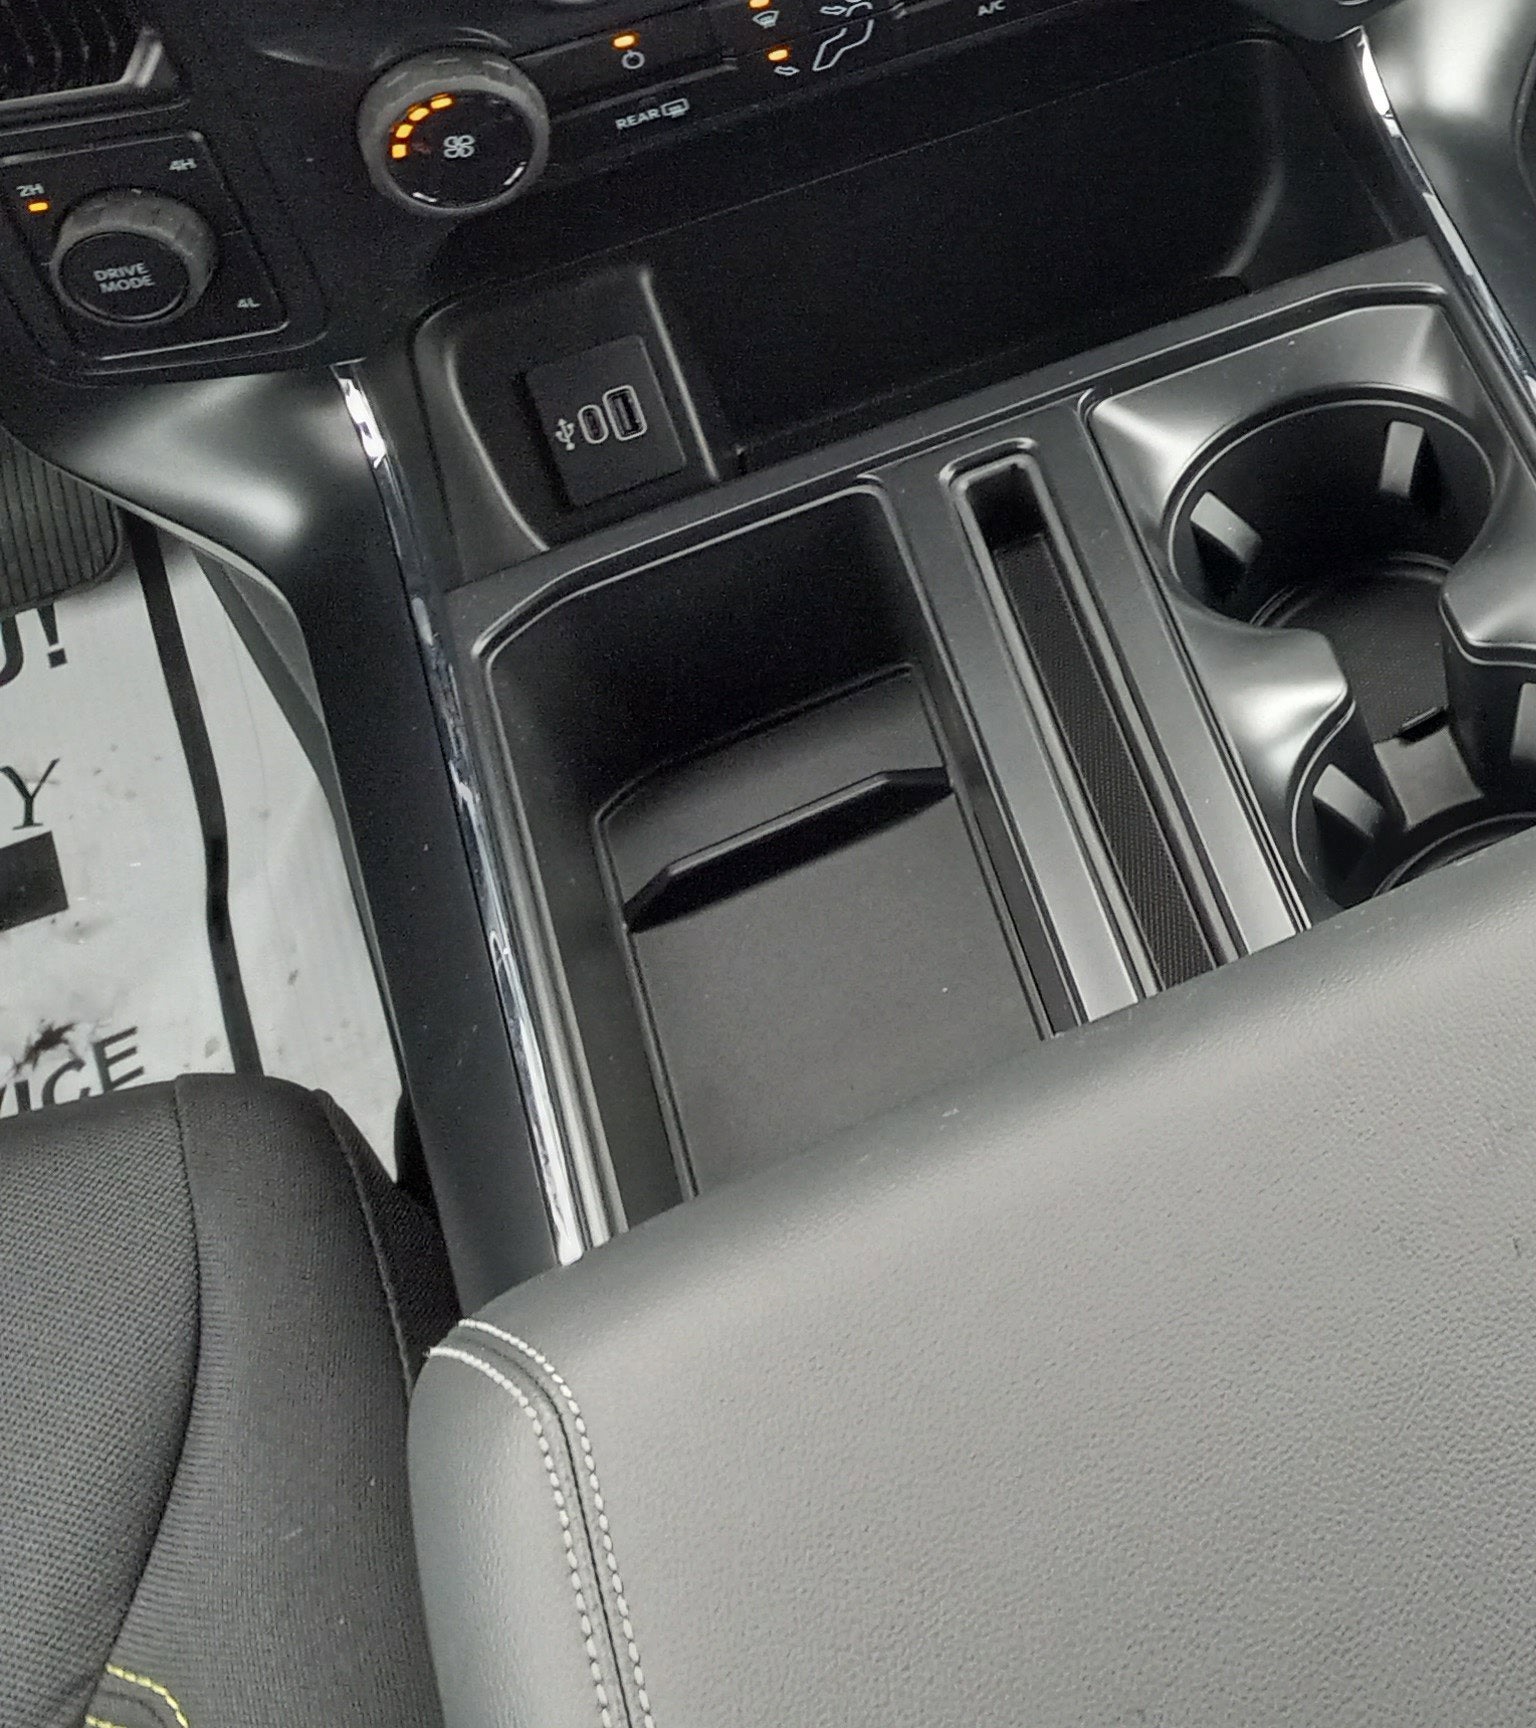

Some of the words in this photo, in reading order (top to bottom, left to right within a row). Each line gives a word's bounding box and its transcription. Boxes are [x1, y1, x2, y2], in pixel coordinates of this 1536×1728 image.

[977, 0, 1006, 16] A/C
[615, 108, 661, 130] REAR
[169, 157, 197, 172] 4H
[16, 183, 45, 197] 2H
[93, 261, 149, 282] DRIVE
[99, 274, 155, 293] MODE
[236, 297, 261, 309] 4L
